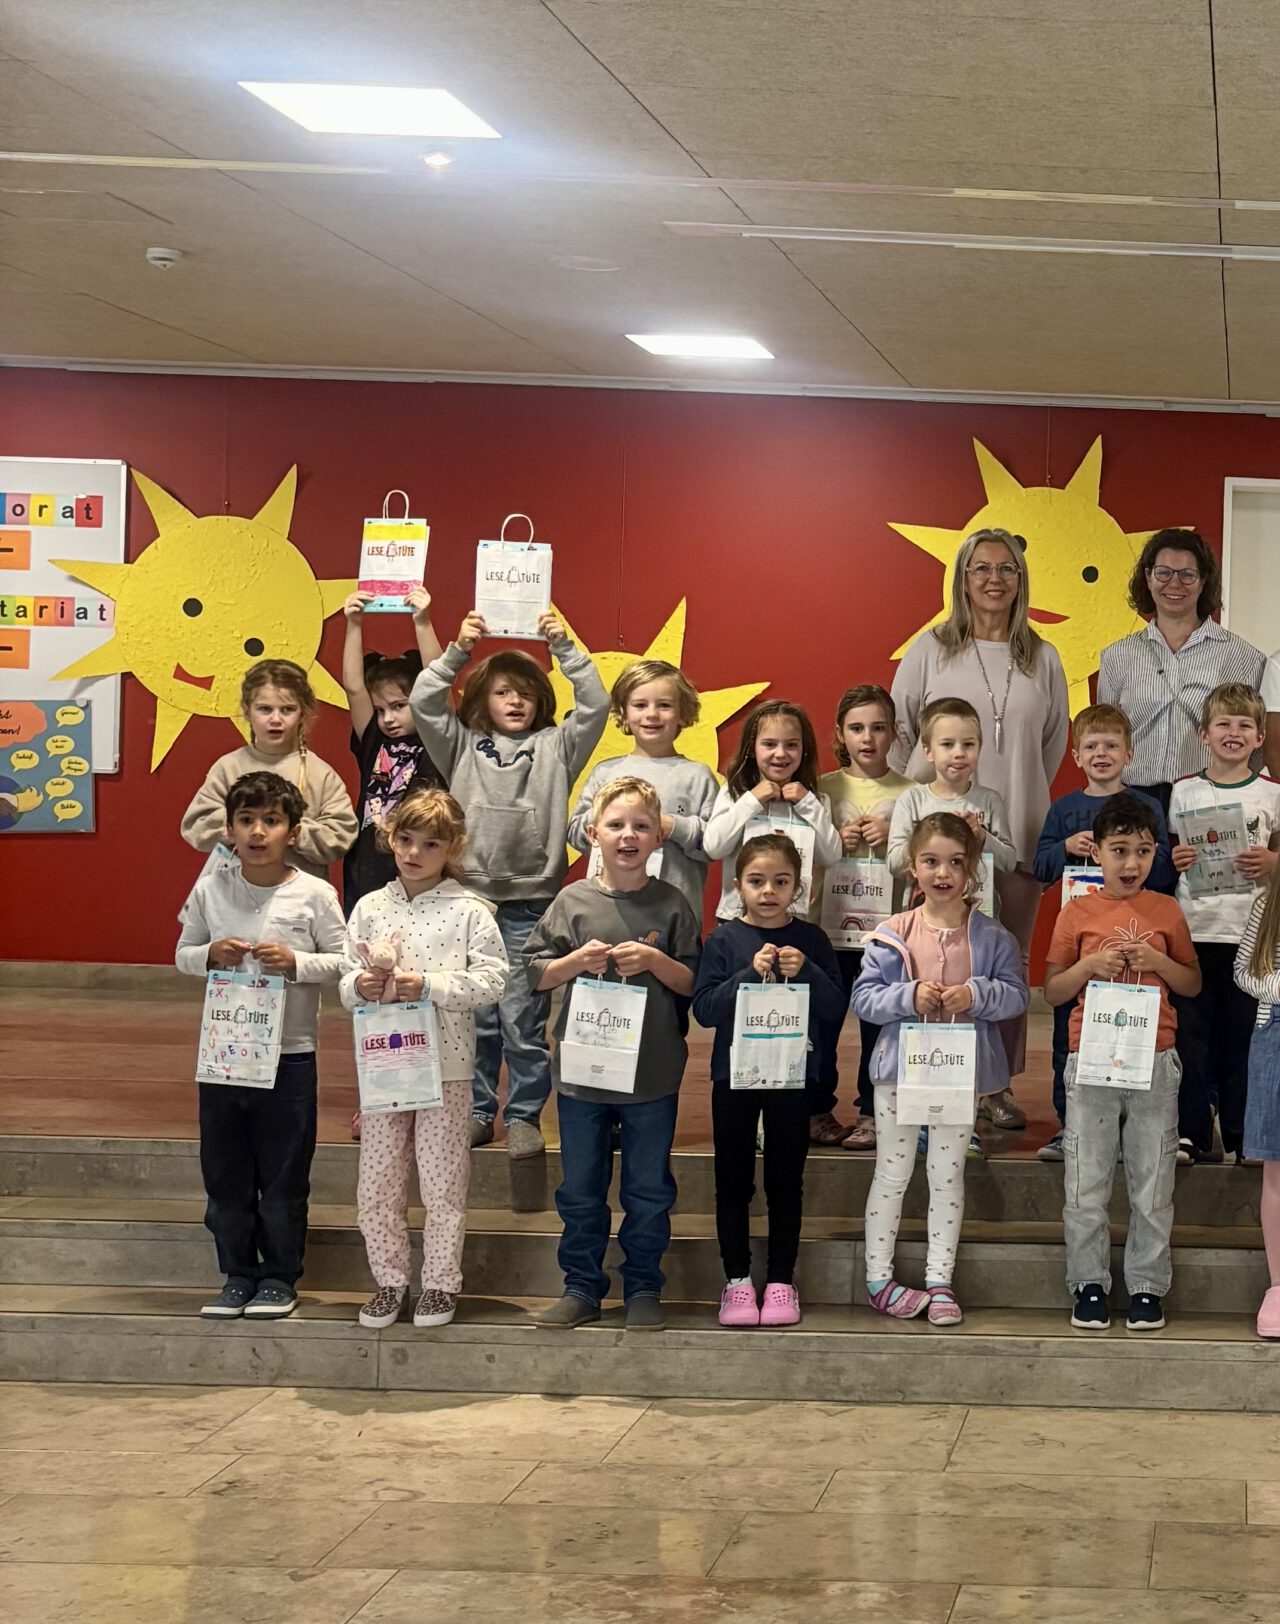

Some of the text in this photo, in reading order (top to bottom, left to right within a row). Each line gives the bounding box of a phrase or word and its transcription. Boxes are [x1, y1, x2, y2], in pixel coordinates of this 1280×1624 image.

[367, 544, 416, 556] LESE TÜTE
[486, 571, 540, 584] LESE TÜTE
[832, 884, 884, 897] LESE TÜTE
[212, 1009, 269, 1024] LESE TÜTE
[576, 1012, 632, 1029] LESE TÜTE
[746, 1014, 800, 1026] LESE TÜTE
[1092, 1013, 1148, 1028] LESE TÜTE
[364, 1034, 426, 1050] LESE TÜTE
[908, 1054, 964, 1066] LESE TÜTE
